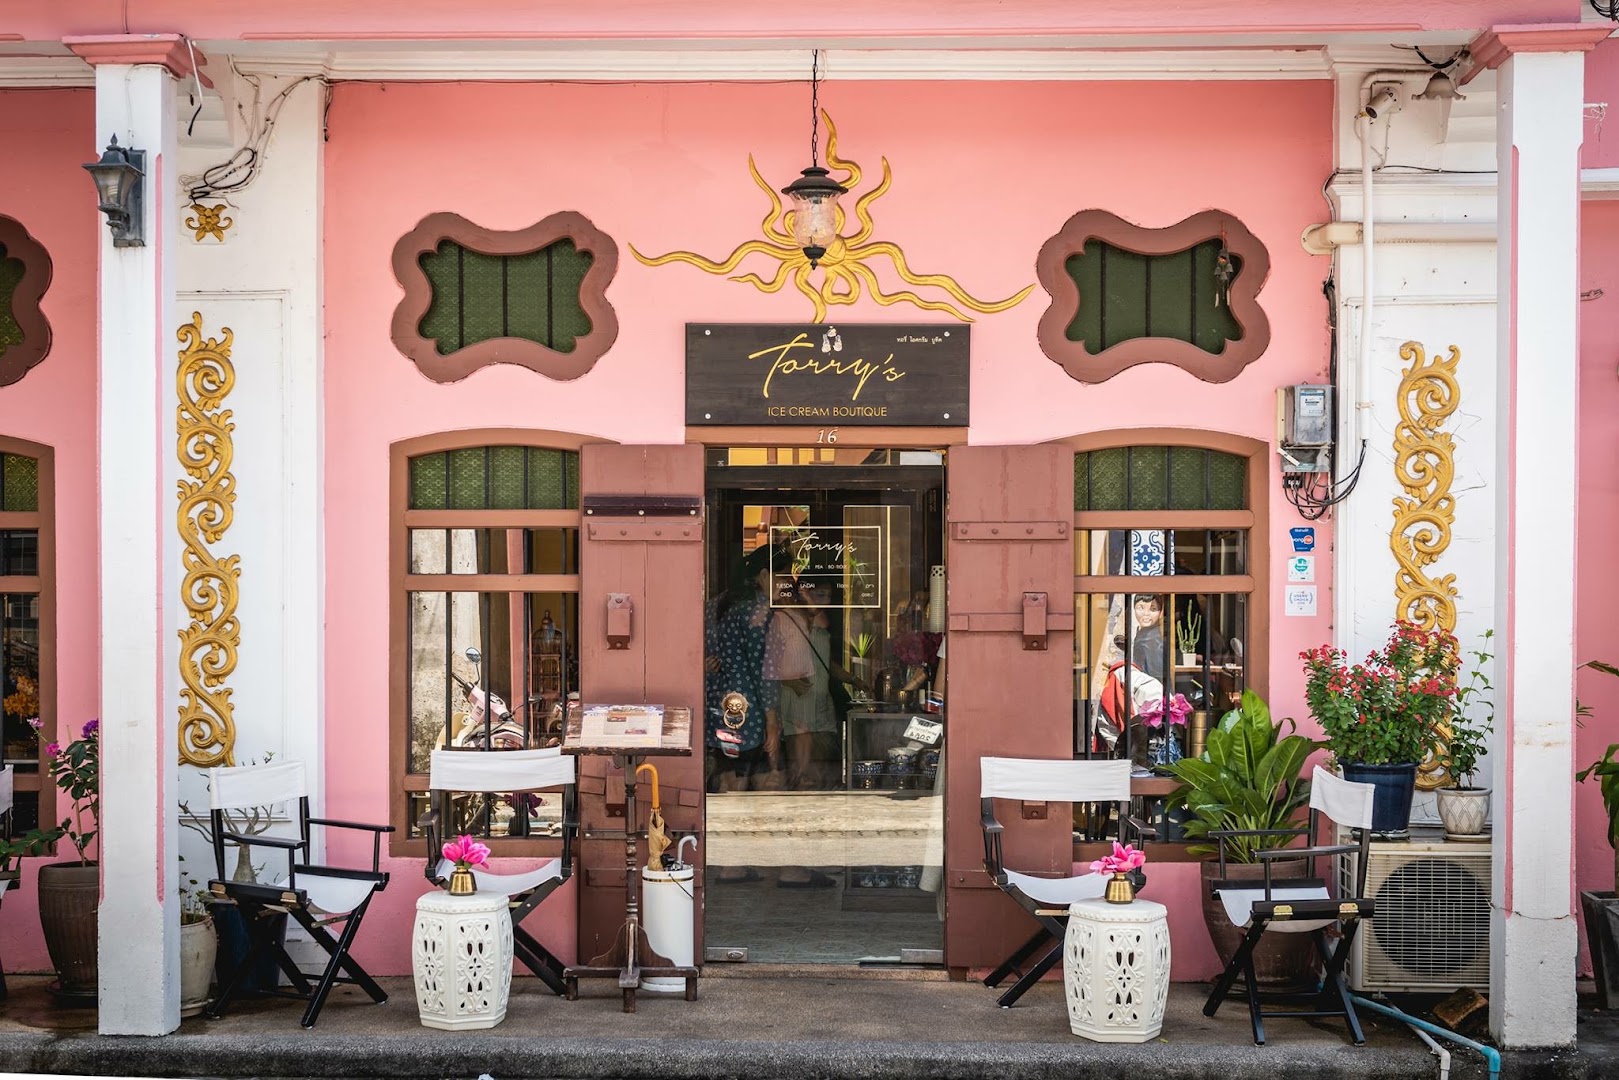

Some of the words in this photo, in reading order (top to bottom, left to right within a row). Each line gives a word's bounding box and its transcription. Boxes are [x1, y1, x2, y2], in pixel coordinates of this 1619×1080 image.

[748, 332, 906, 401] Torry's
[767, 406, 786, 417] ICE
[788, 406, 830, 417] CREAM
[832, 406, 888, 417] BOUTIQUE
[816, 428, 839, 444] 16
